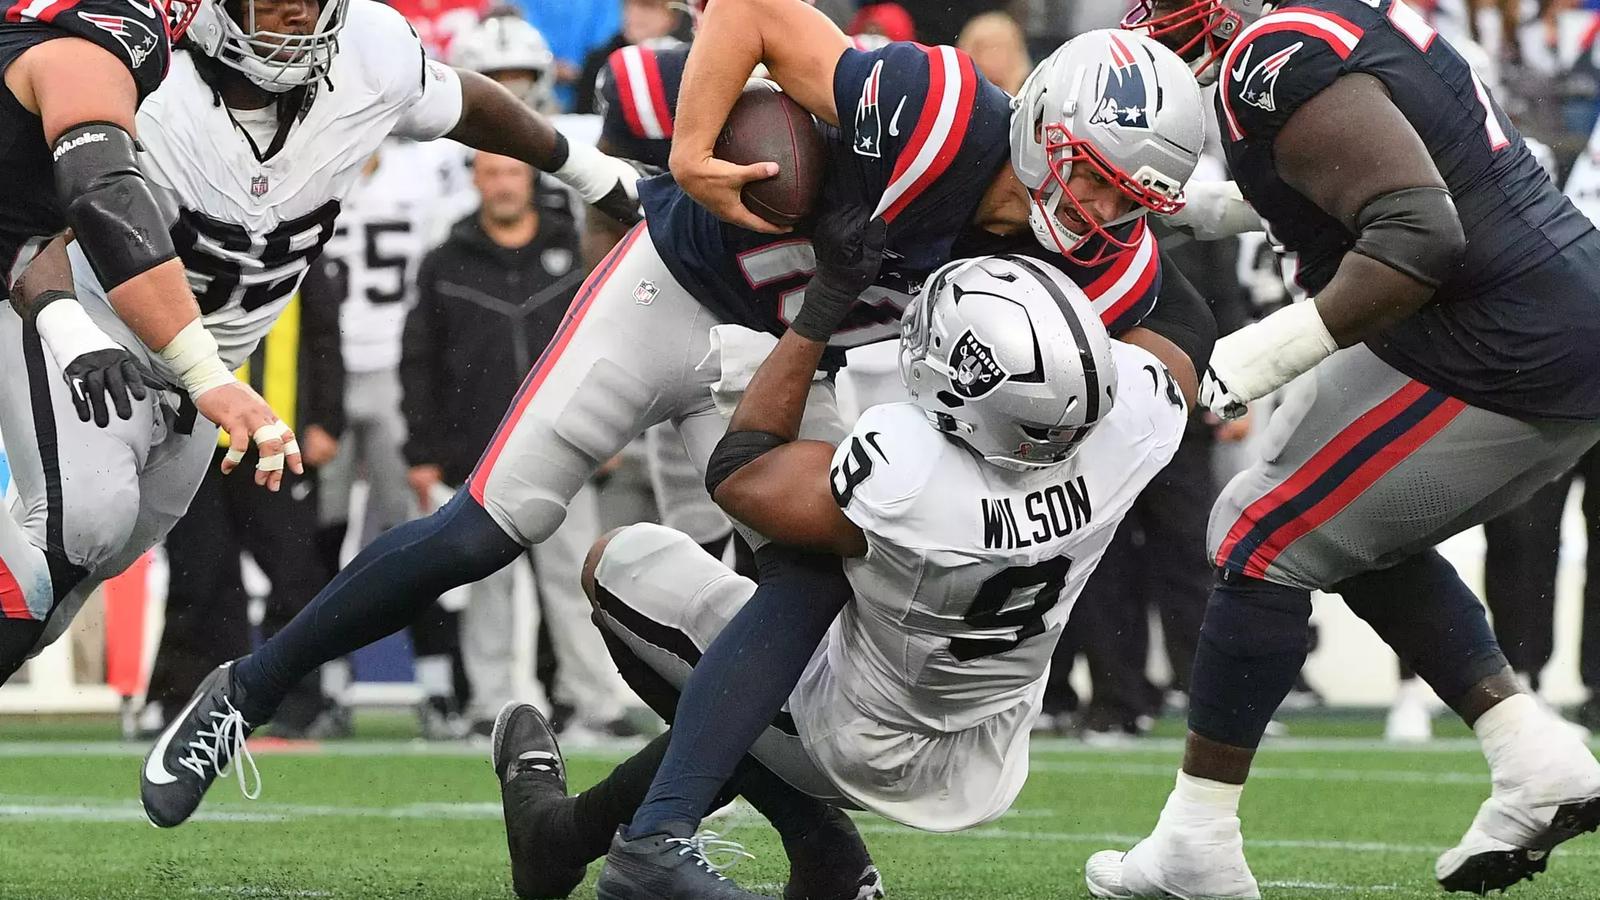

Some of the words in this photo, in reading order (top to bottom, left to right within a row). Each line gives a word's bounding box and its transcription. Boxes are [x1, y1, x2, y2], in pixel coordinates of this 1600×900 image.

[966, 334, 1001, 377] RAIDERS
[830, 436, 873, 508] 9
[981, 475, 1092, 550] WILSON
[948, 554, 1073, 663] 9
